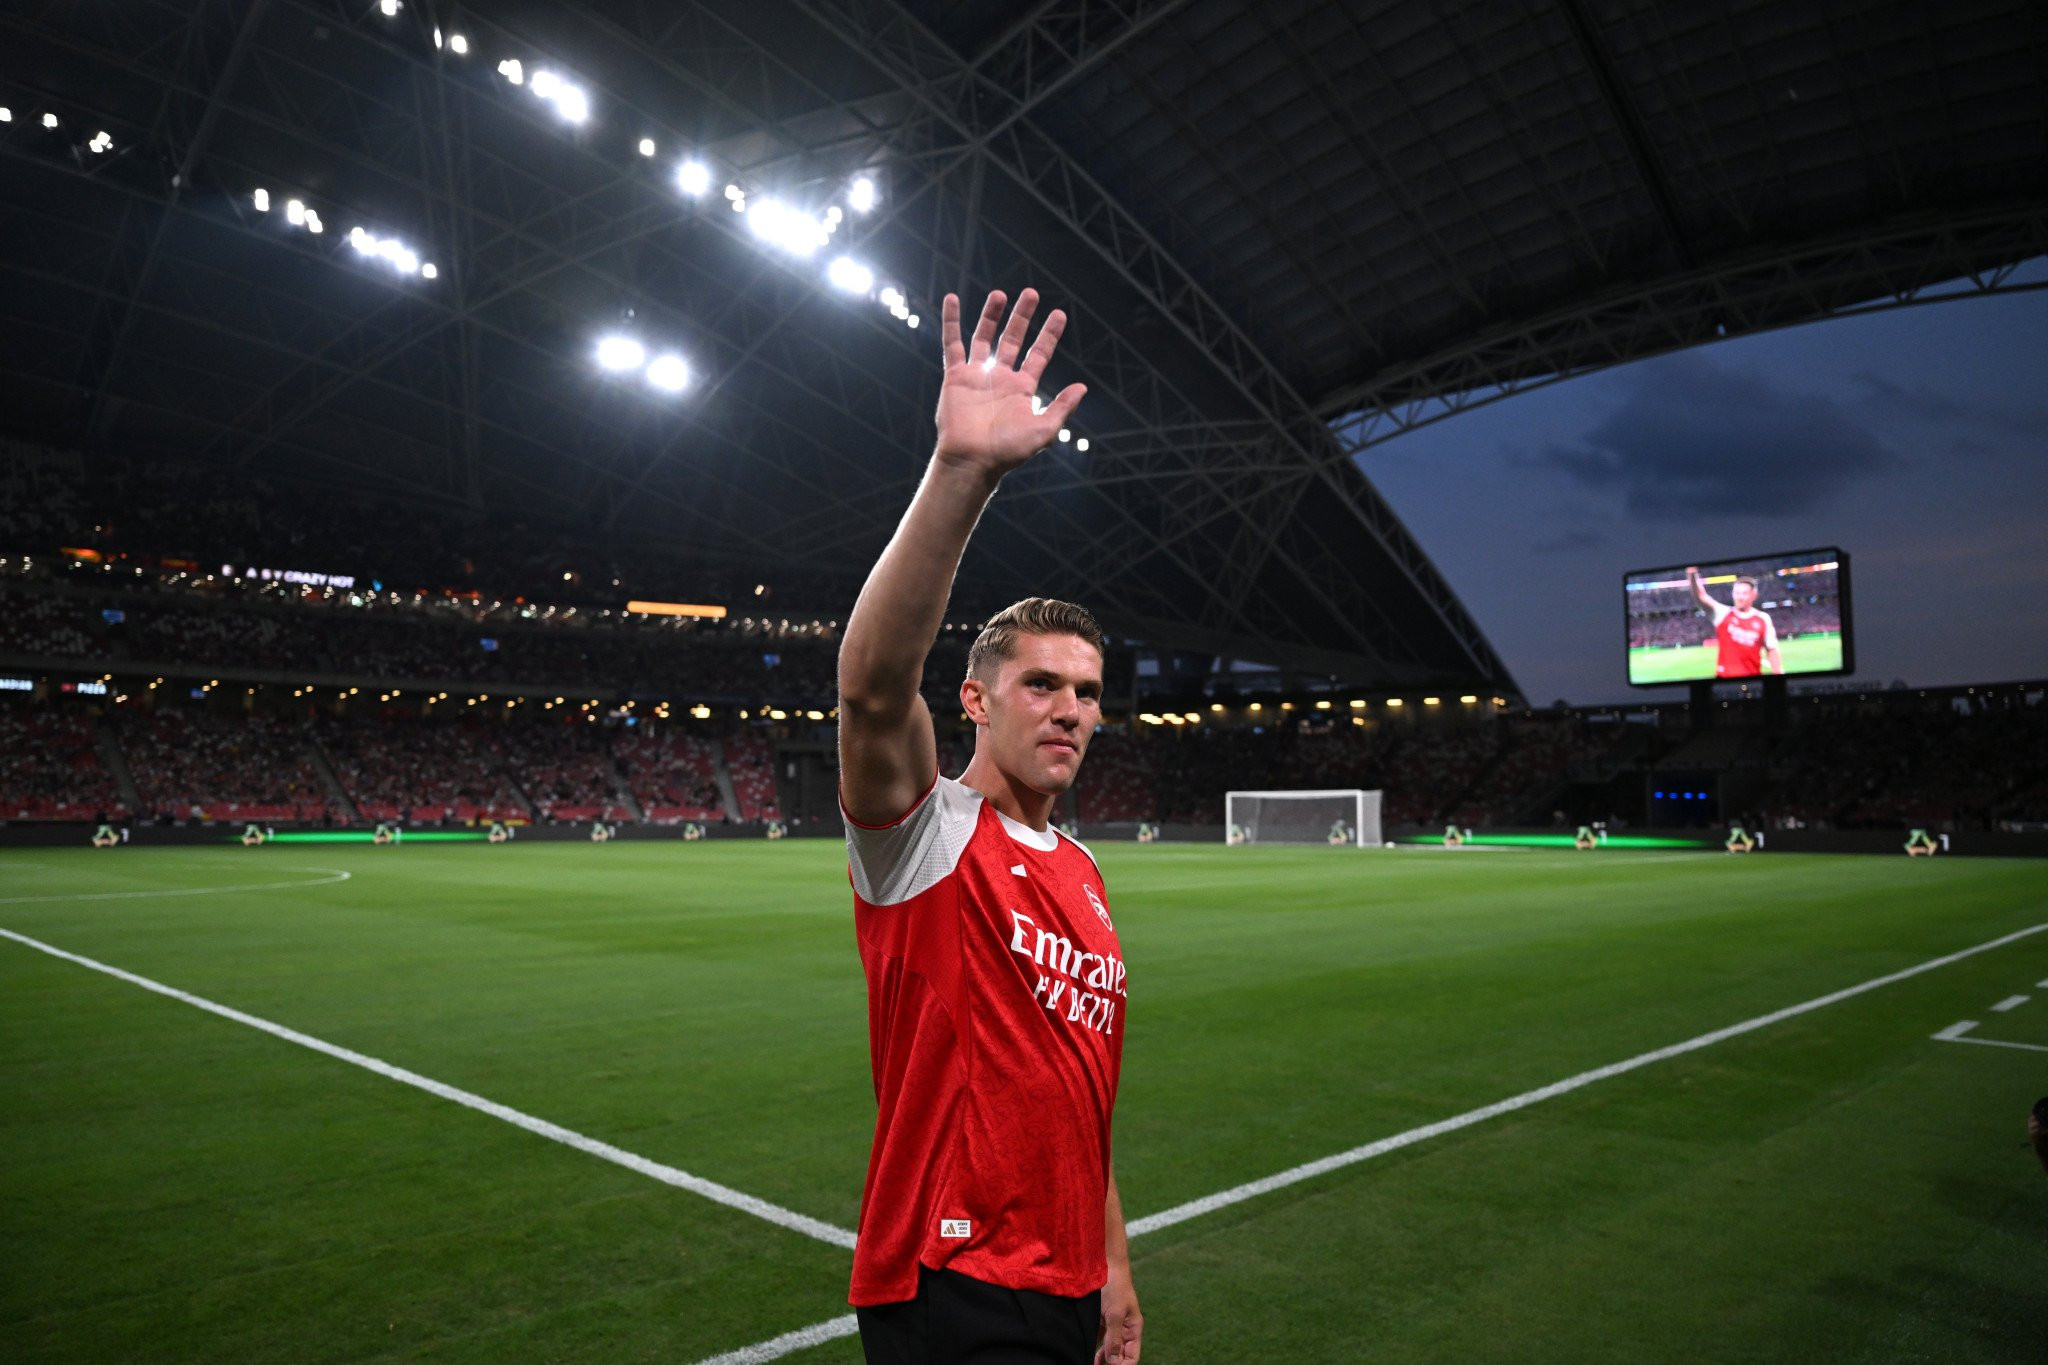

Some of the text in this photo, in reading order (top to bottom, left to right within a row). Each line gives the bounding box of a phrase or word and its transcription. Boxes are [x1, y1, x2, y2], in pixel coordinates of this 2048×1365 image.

[284, 570, 328, 586] CRAZY
[1010, 908, 1128, 998] Emirate
[1067, 988, 1116, 1035] BETT
